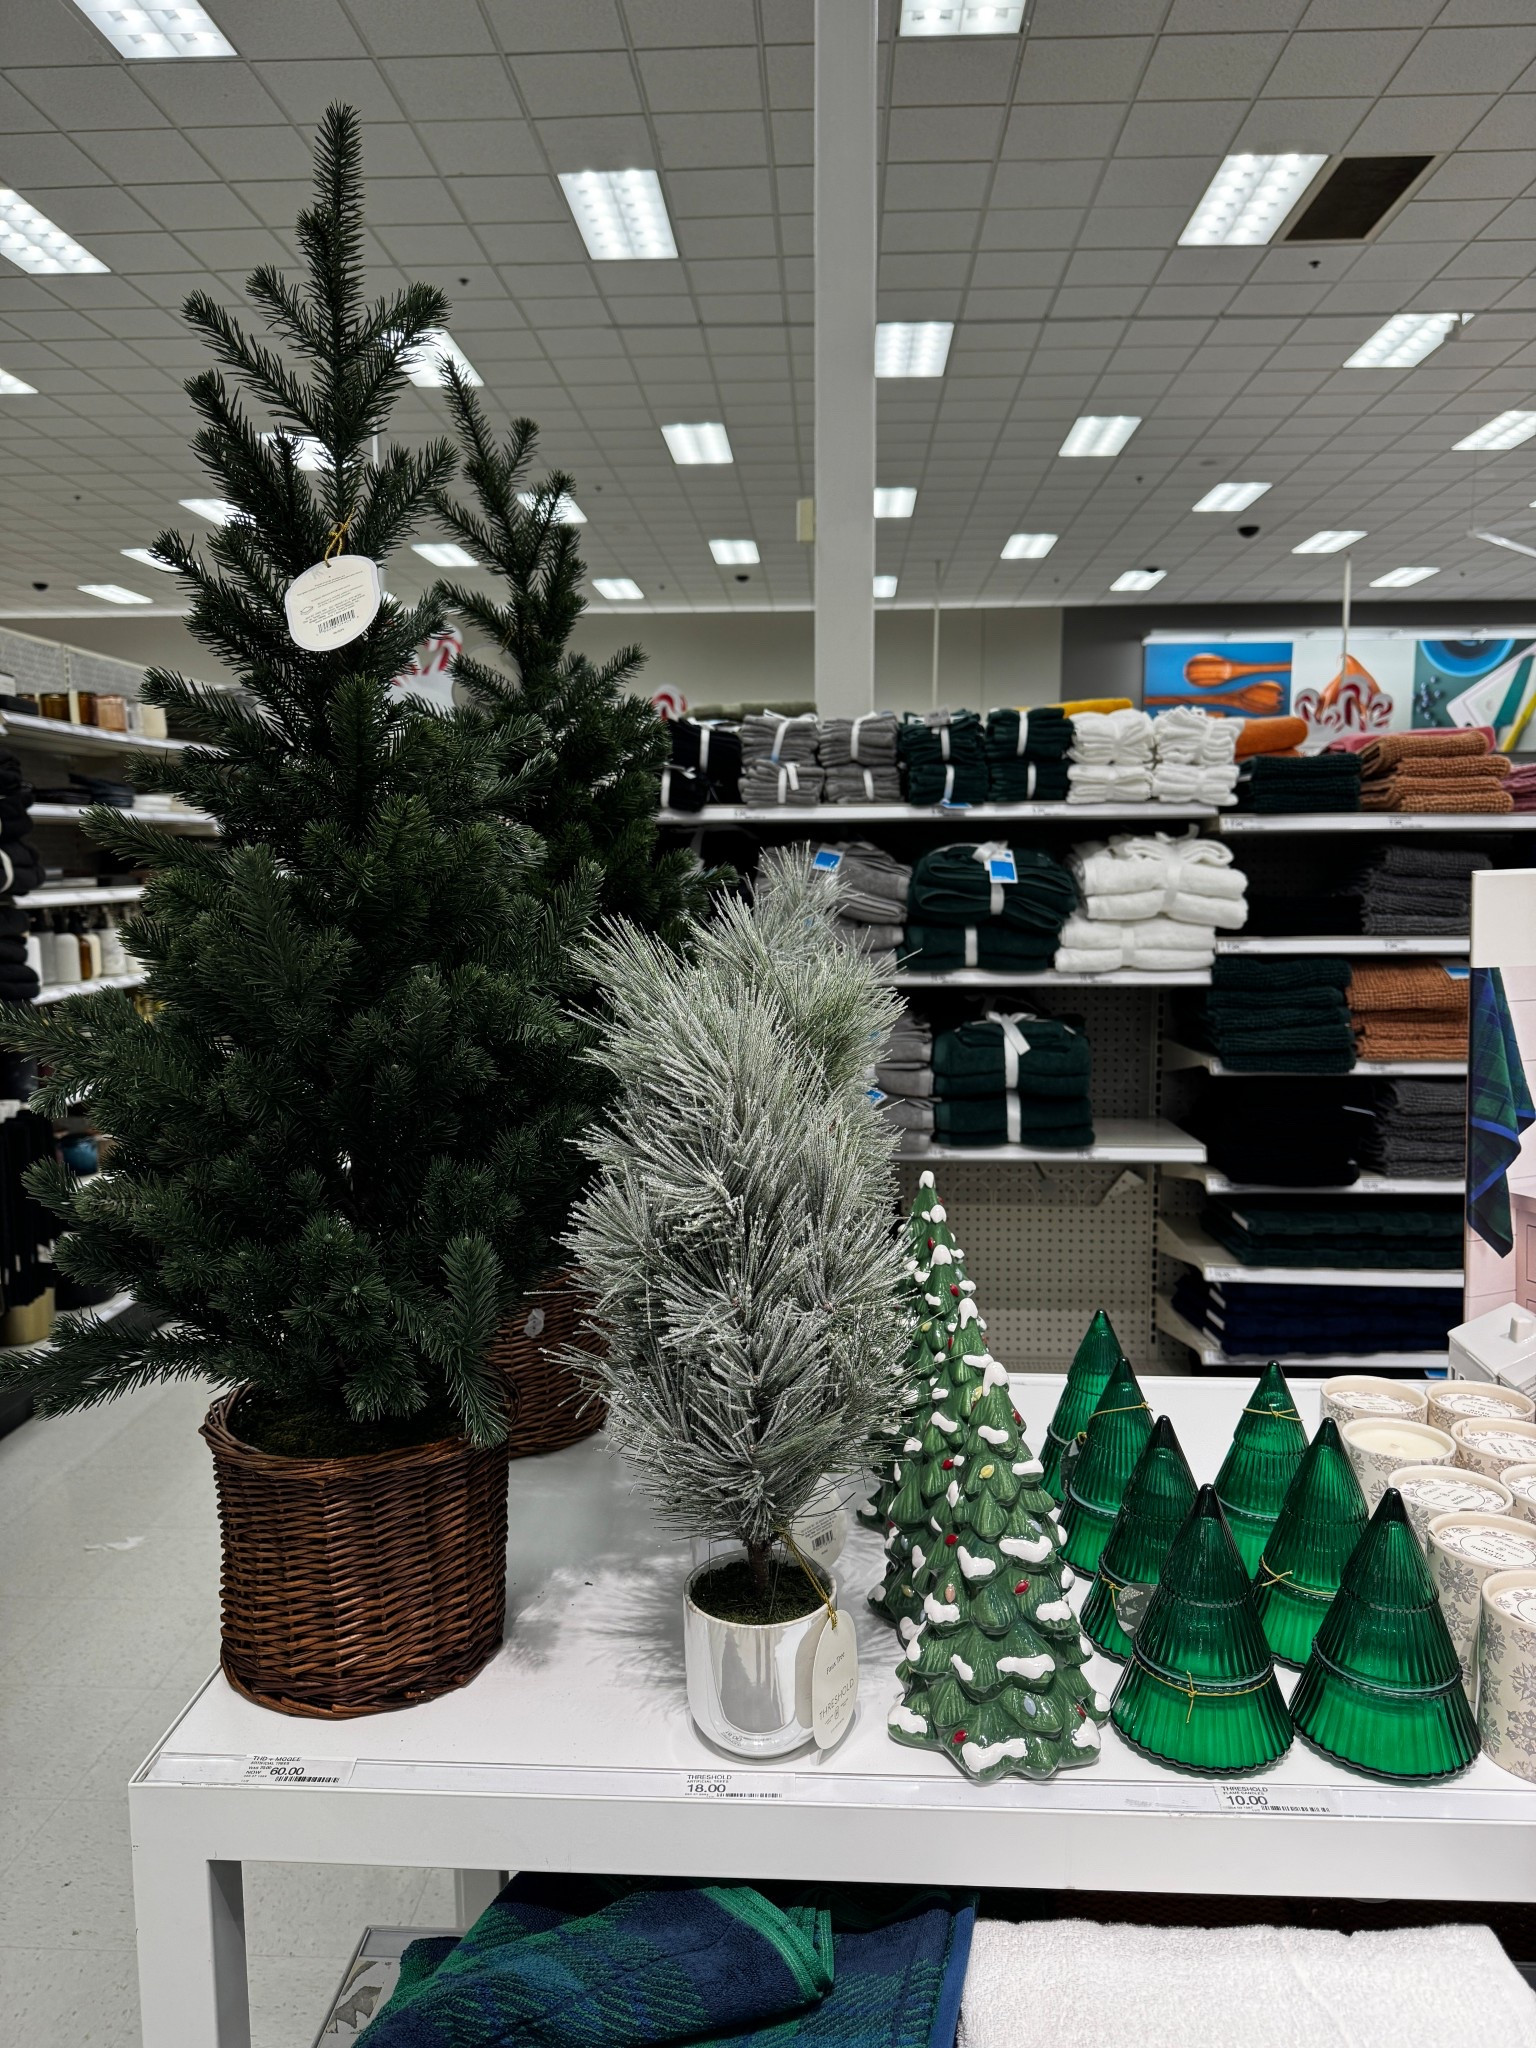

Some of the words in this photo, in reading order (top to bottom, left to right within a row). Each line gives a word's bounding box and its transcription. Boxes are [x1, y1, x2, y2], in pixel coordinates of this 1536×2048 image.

[818, 1678, 854, 1720] THRESHOLD
[270, 1766, 305, 1776] 60.00
[687, 1783, 726, 1792] 18.00
[1226, 1795, 1268, 1805] 10.00
